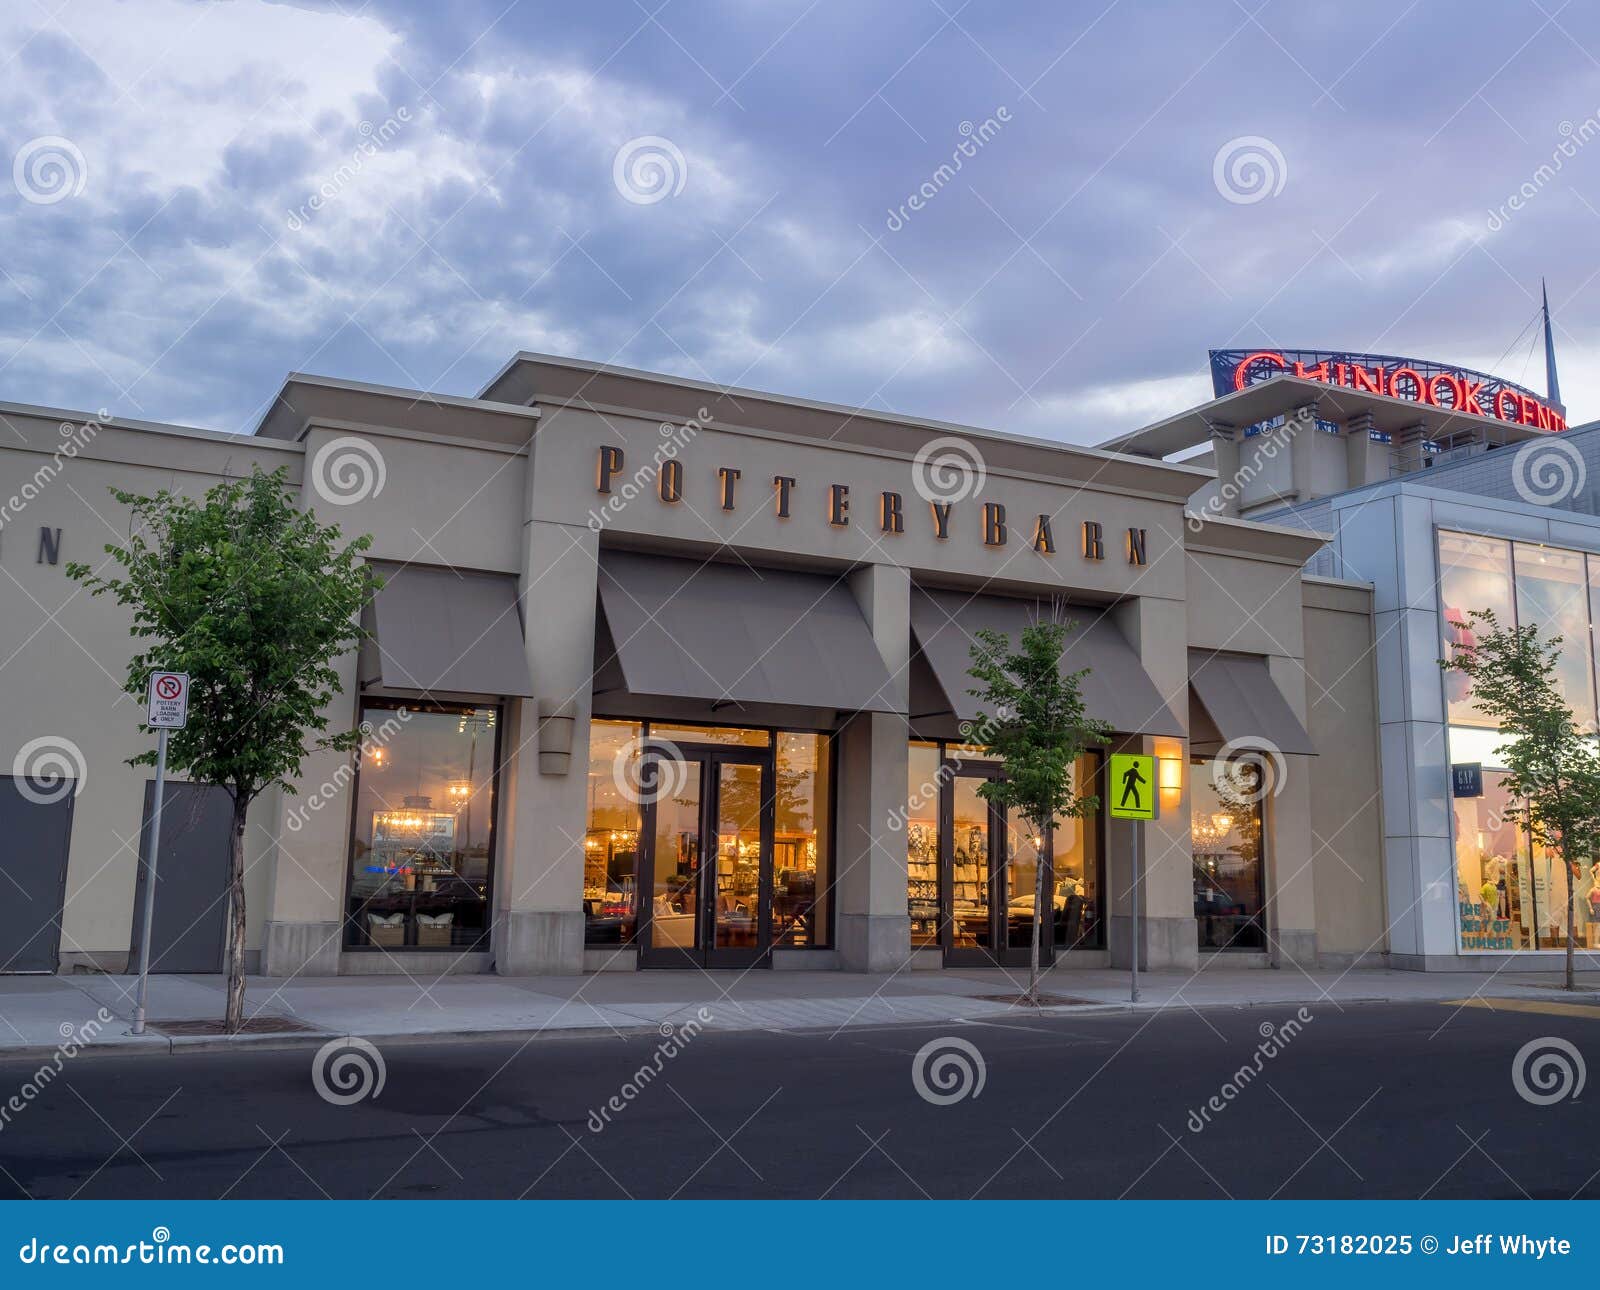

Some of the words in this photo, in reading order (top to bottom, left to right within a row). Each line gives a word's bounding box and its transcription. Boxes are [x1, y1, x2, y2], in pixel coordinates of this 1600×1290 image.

[1234, 352, 1486, 416] CHINOOK
[1458, 770, 1473, 785] GAP
[1493, 920, 1509, 932] OF
[1461, 936, 1513, 950] SUMMER
